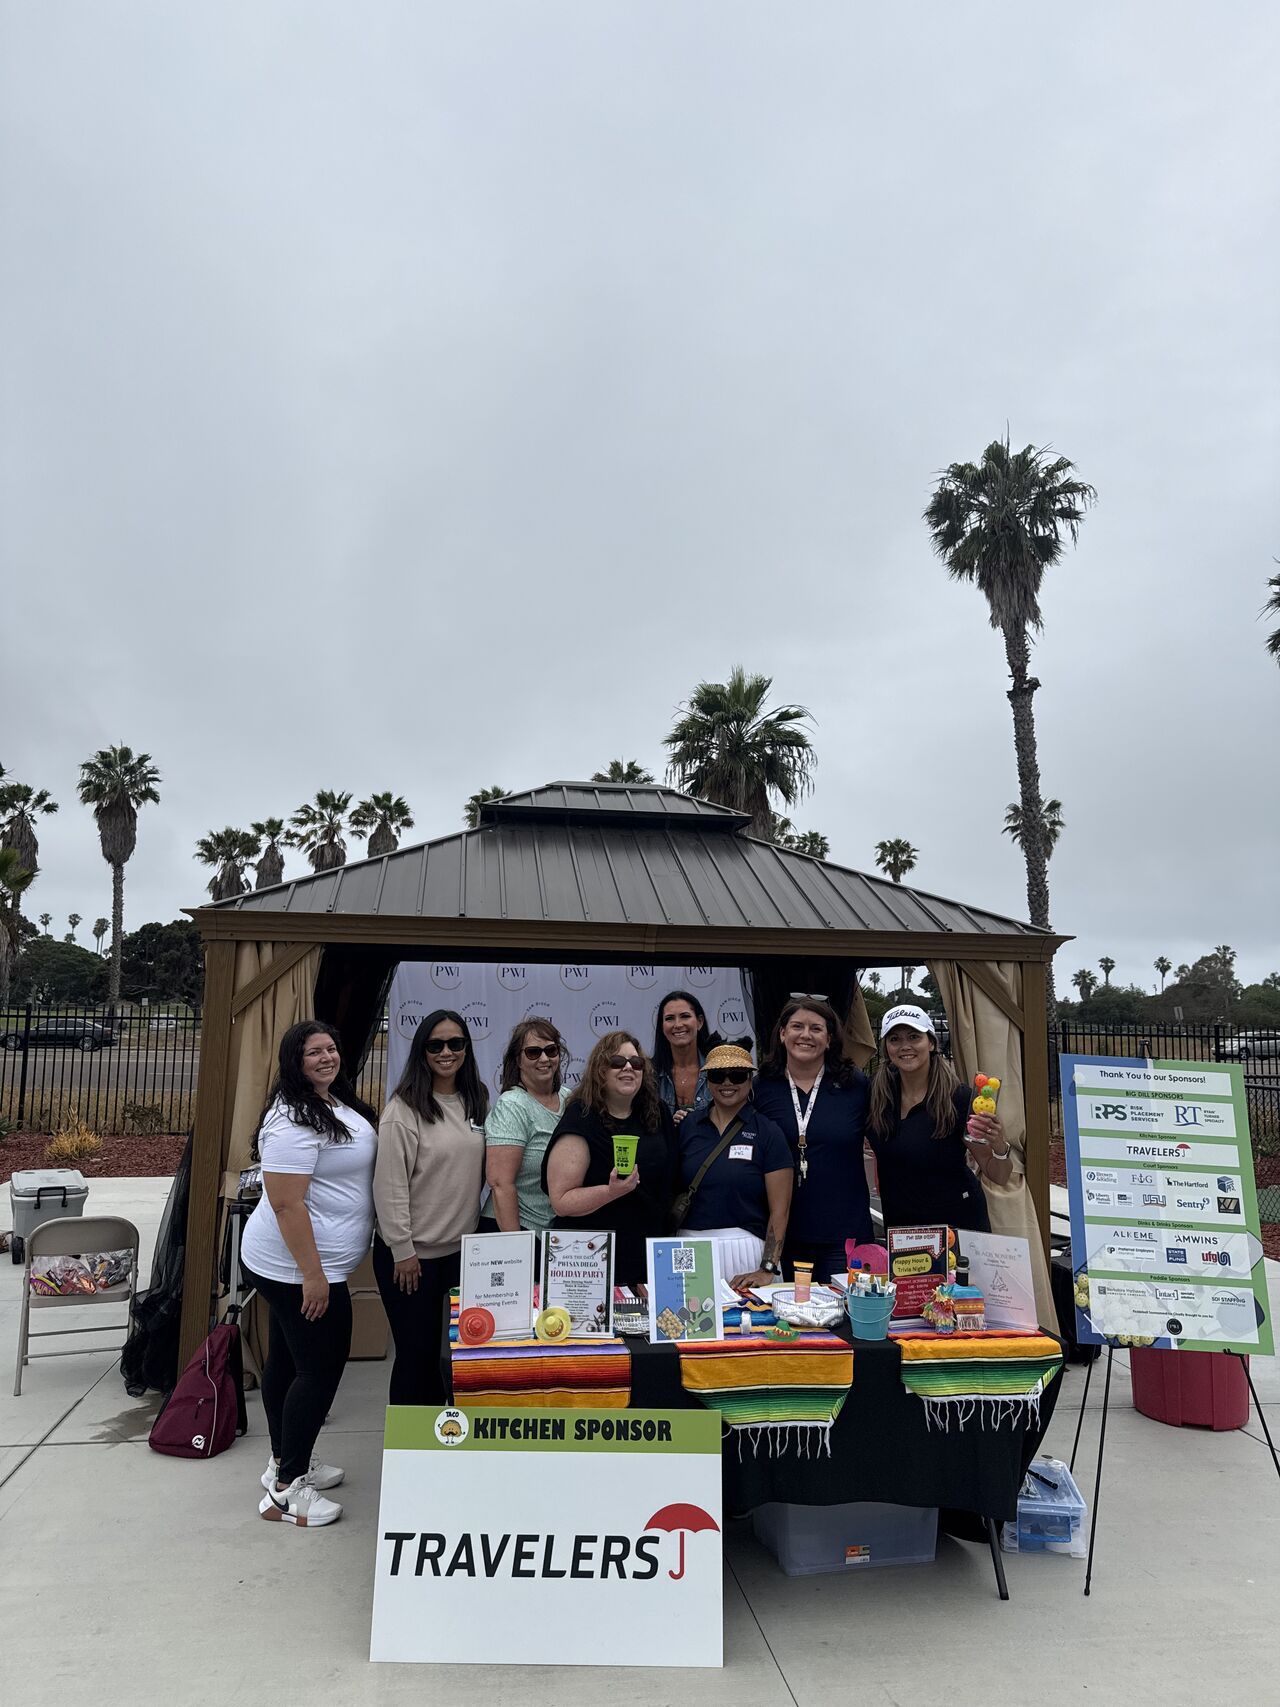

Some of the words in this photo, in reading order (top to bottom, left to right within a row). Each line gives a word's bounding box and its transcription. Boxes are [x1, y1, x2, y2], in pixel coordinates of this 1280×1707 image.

[435, 965, 460, 977] PWI
[502, 967, 526, 978] PWI
[564, 967, 589, 978] PWI
[631, 966, 655, 976] PWI
[594, 1016, 619, 1027] PWI
[722, 1012, 744, 1023] PWI
[563, 1072, 582, 1084] PW
[1100, 1071, 1124, 1079] Thank
[1126, 1072, 1142, 1080] You
[1168, 1074, 1206, 1084] Sponsors!
[1151, 1092, 1184, 1100] SPONSORS
[1095, 1104, 1127, 1121] RPS
[1174, 1105, 1202, 1123] RT
[1127, 1146, 1181, 1157] TRAVELERS
[1177, 1199, 1205, 1210] Sentry
[1113, 1230, 1153, 1239] ALKEME
[1175, 1234, 1218, 1244] AMWINS
[1202, 1251, 1217, 1262] ufg
[550, 1270, 581, 1278] HOLIDAY
[582, 1271, 605, 1279] PARTY
[473, 1417, 566, 1440] KITCHEN
[573, 1418, 673, 1441] SPONSOR
[384, 1532, 661, 1580] TRAVELERS
